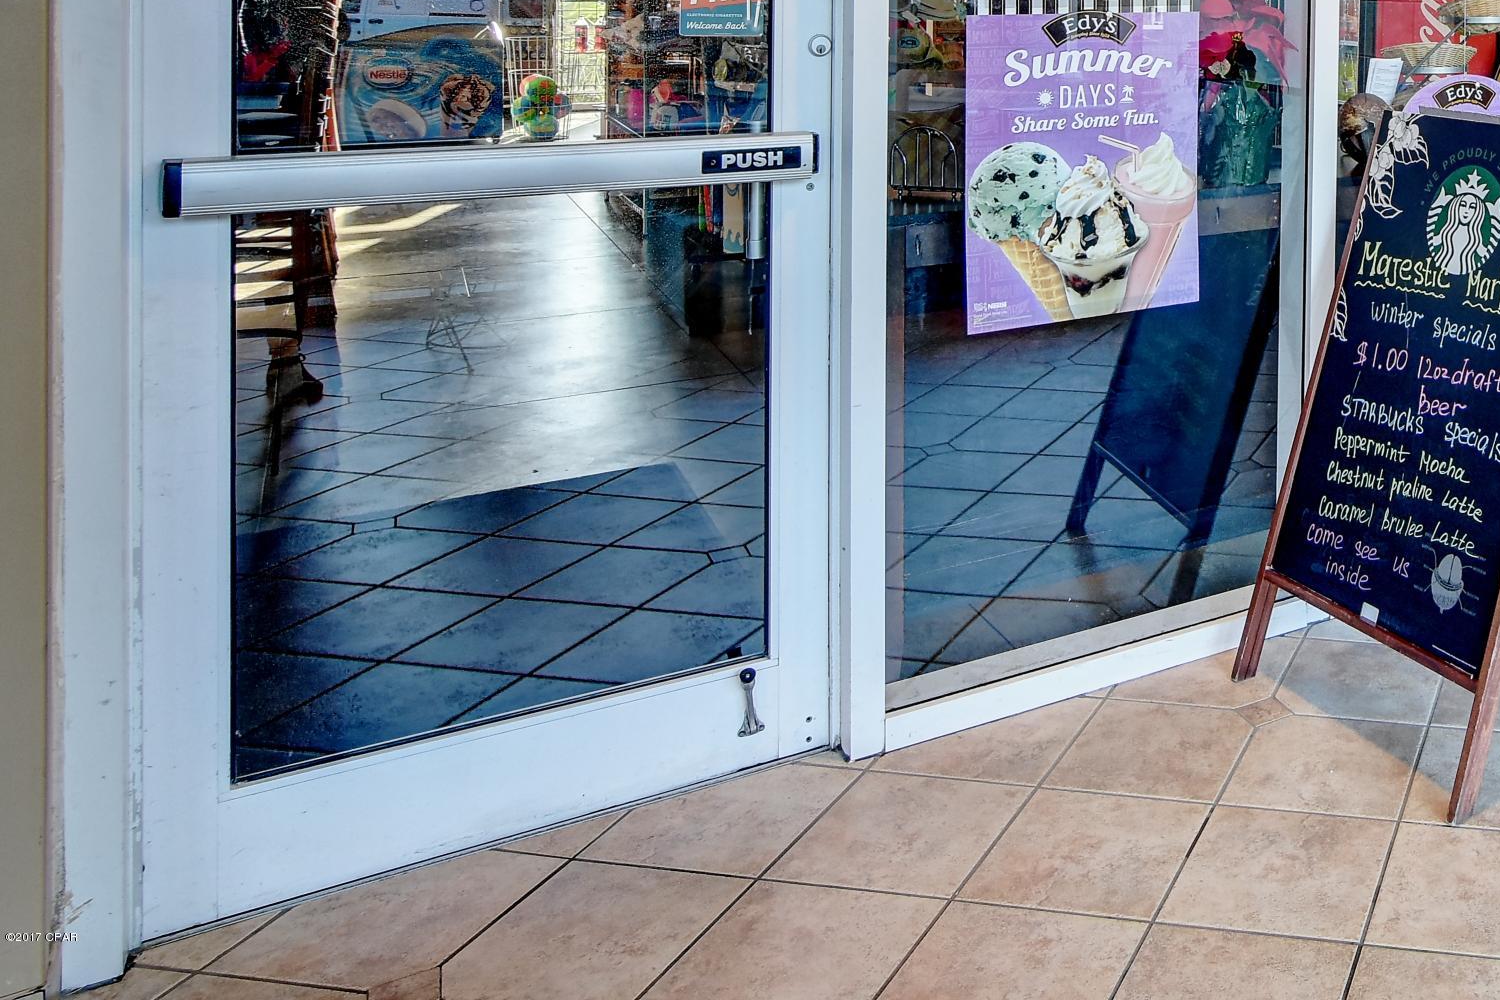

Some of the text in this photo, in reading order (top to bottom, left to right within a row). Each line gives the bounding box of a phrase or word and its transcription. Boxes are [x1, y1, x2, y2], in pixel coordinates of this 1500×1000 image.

[686, 21, 722, 30] Welcome
[1062, 13, 1118, 35] Edy's
[1004, 49, 1173, 88] Summer
[1059, 84, 1116, 109] DAYS
[1446, 82, 1483, 101] Edy's
[1011, 109, 1159, 134] Share Some Fun.
[721, 151, 783, 169] PUSH
[1425, 172, 1440, 192] WE
[1443, 147, 1497, 170] PROUDLY
[1357, 241, 1450, 288] Majestic
[1353, 341, 1408, 371] $1.00
[1334, 427, 1470, 484] Peppermint Mocha
[1327, 461, 1384, 491] Chestnut
[1442, 490, 1483, 523] Latte
[1318, 496, 1375, 527] Caramel
[1430, 521, 1479, 558] Latte
[1325, 556, 1372, 591] inside
